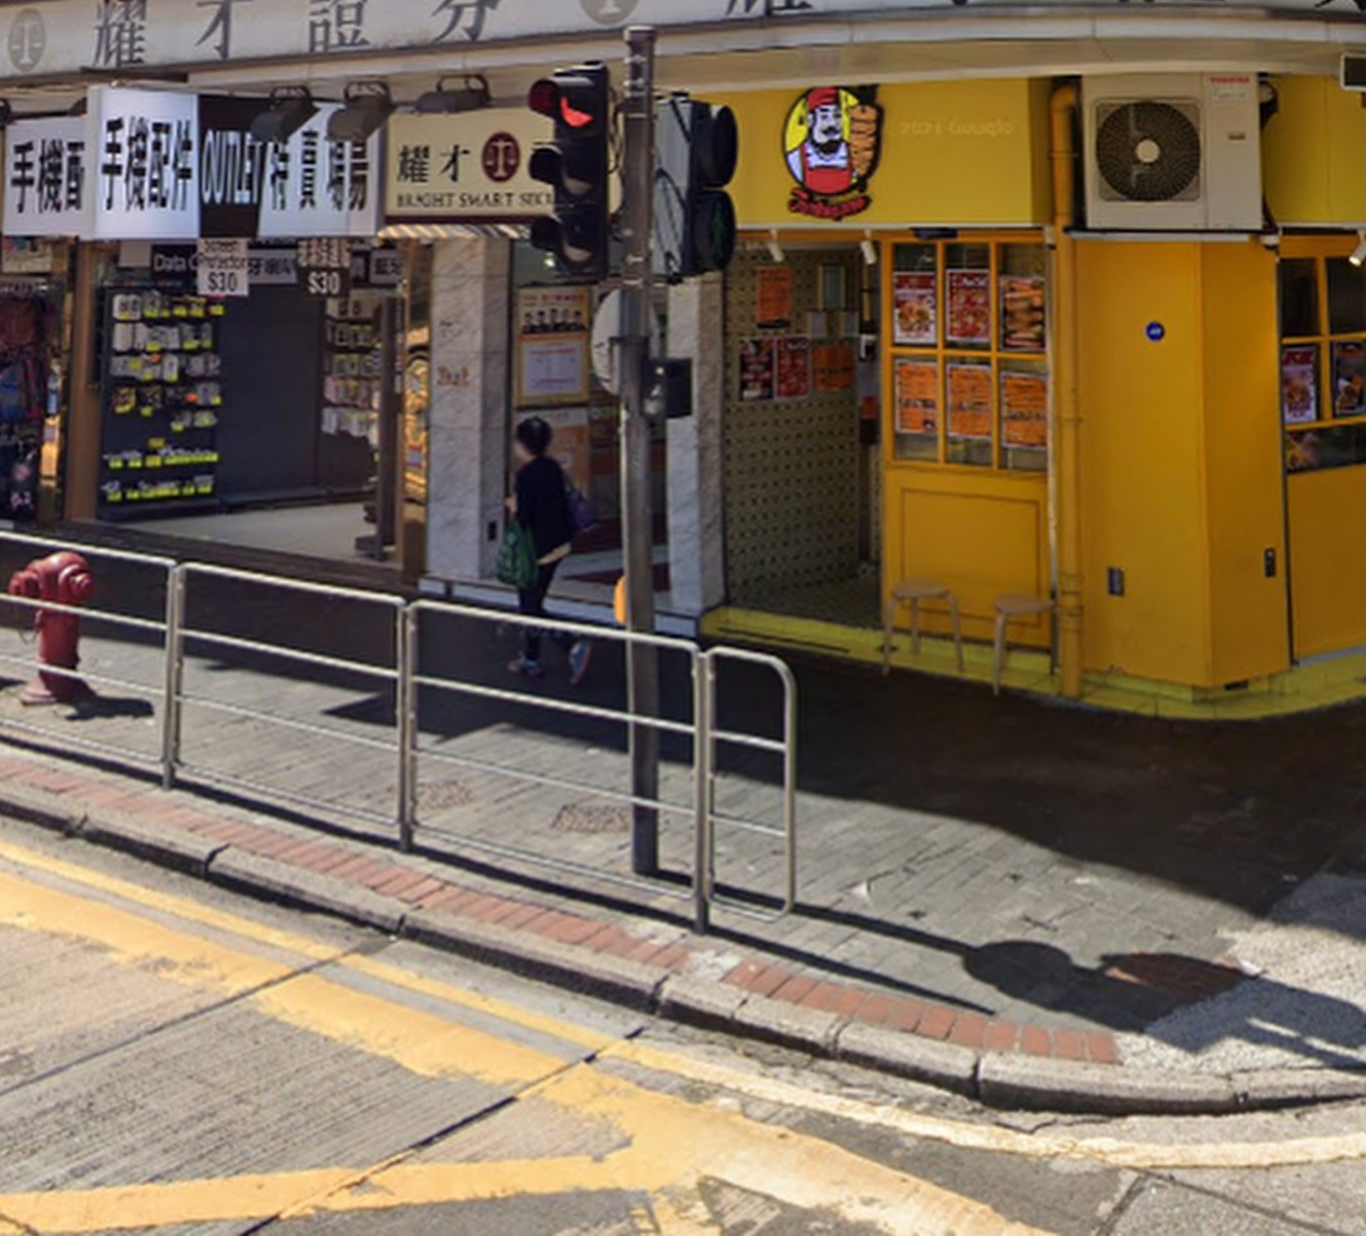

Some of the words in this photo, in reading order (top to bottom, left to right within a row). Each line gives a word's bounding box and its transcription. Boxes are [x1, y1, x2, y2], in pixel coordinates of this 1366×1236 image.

[101, 118, 194, 212] 手機配件
[201, 129, 263, 205] OUTLET
[396, 144, 471, 184] 耀才
[396, 192, 454, 210] BRIGHT
[458, 192, 513, 209] SMART
[207, 270, 238, 293] $30
[306, 271, 342, 295] $30
